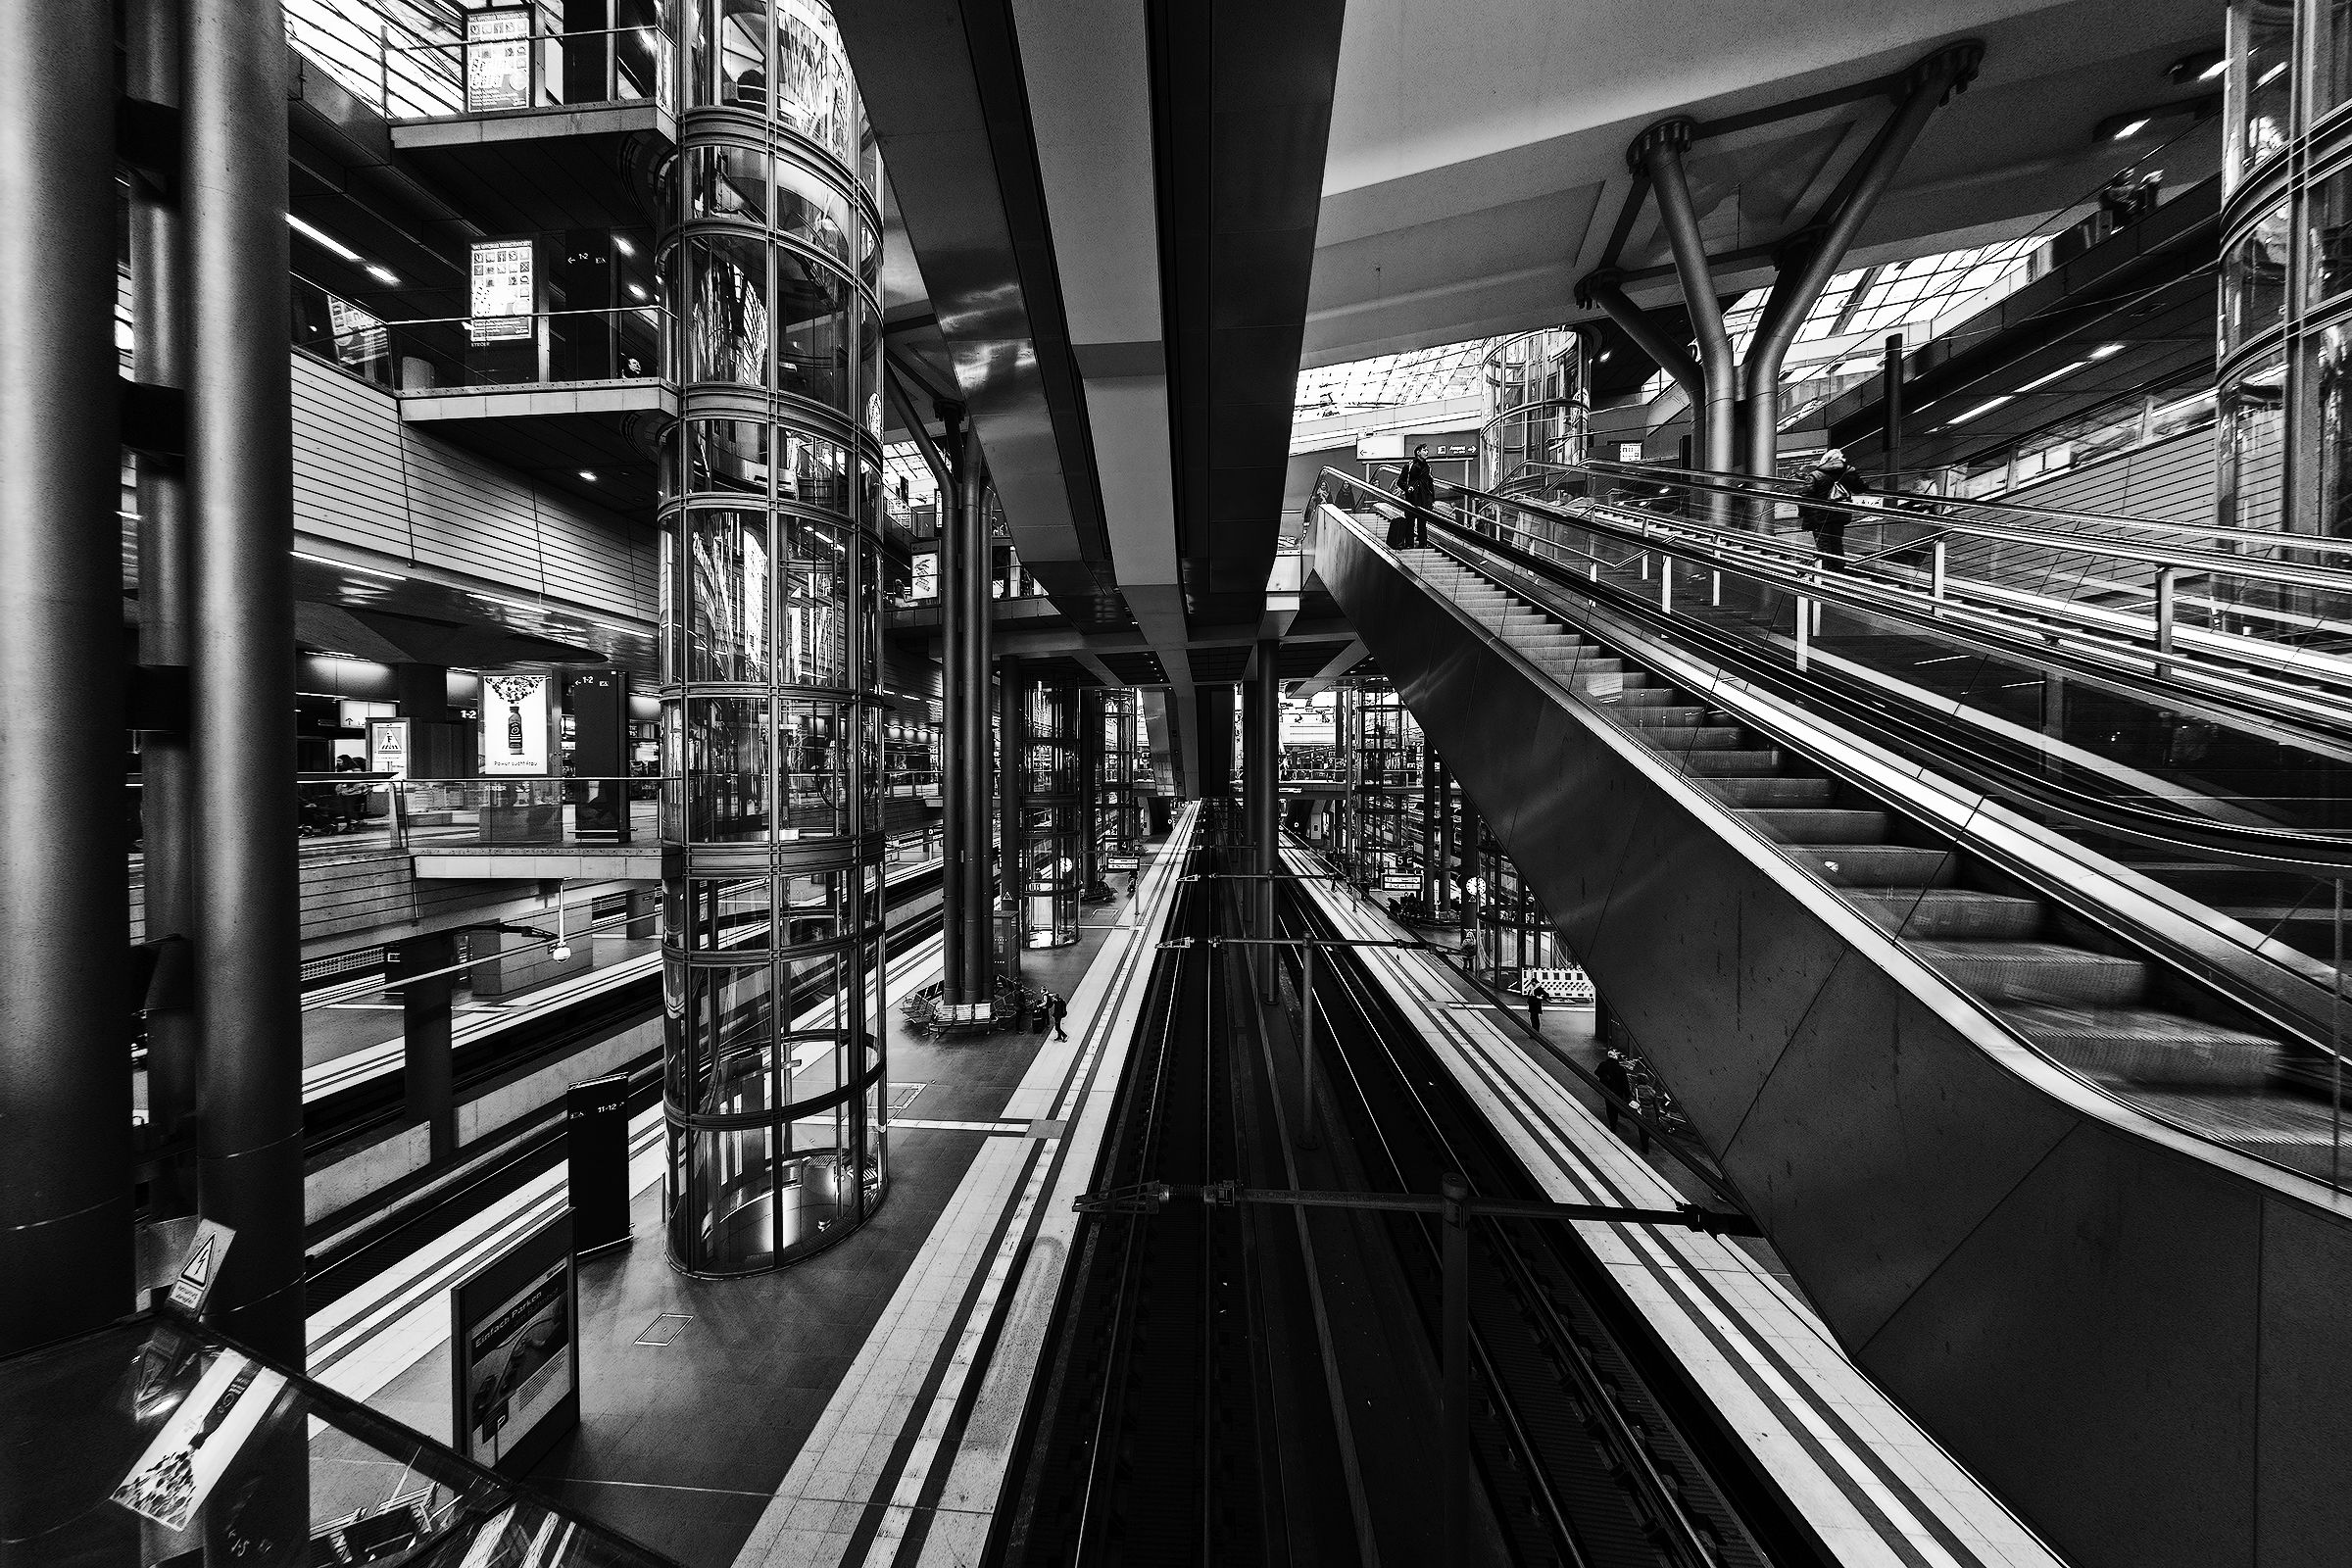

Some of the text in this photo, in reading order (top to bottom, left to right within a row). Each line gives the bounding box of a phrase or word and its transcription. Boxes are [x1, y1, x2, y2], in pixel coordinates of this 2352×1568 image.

[582, 675, 594, 684] 1-2
[460, 710, 477, 719] 1-2
[1396, 856, 1403, 865] 5
[597, 1102, 617, 1113] 11-12
[475, 1291, 542, 1348] Einfach Parken
[497, 1414, 507, 1431] P
